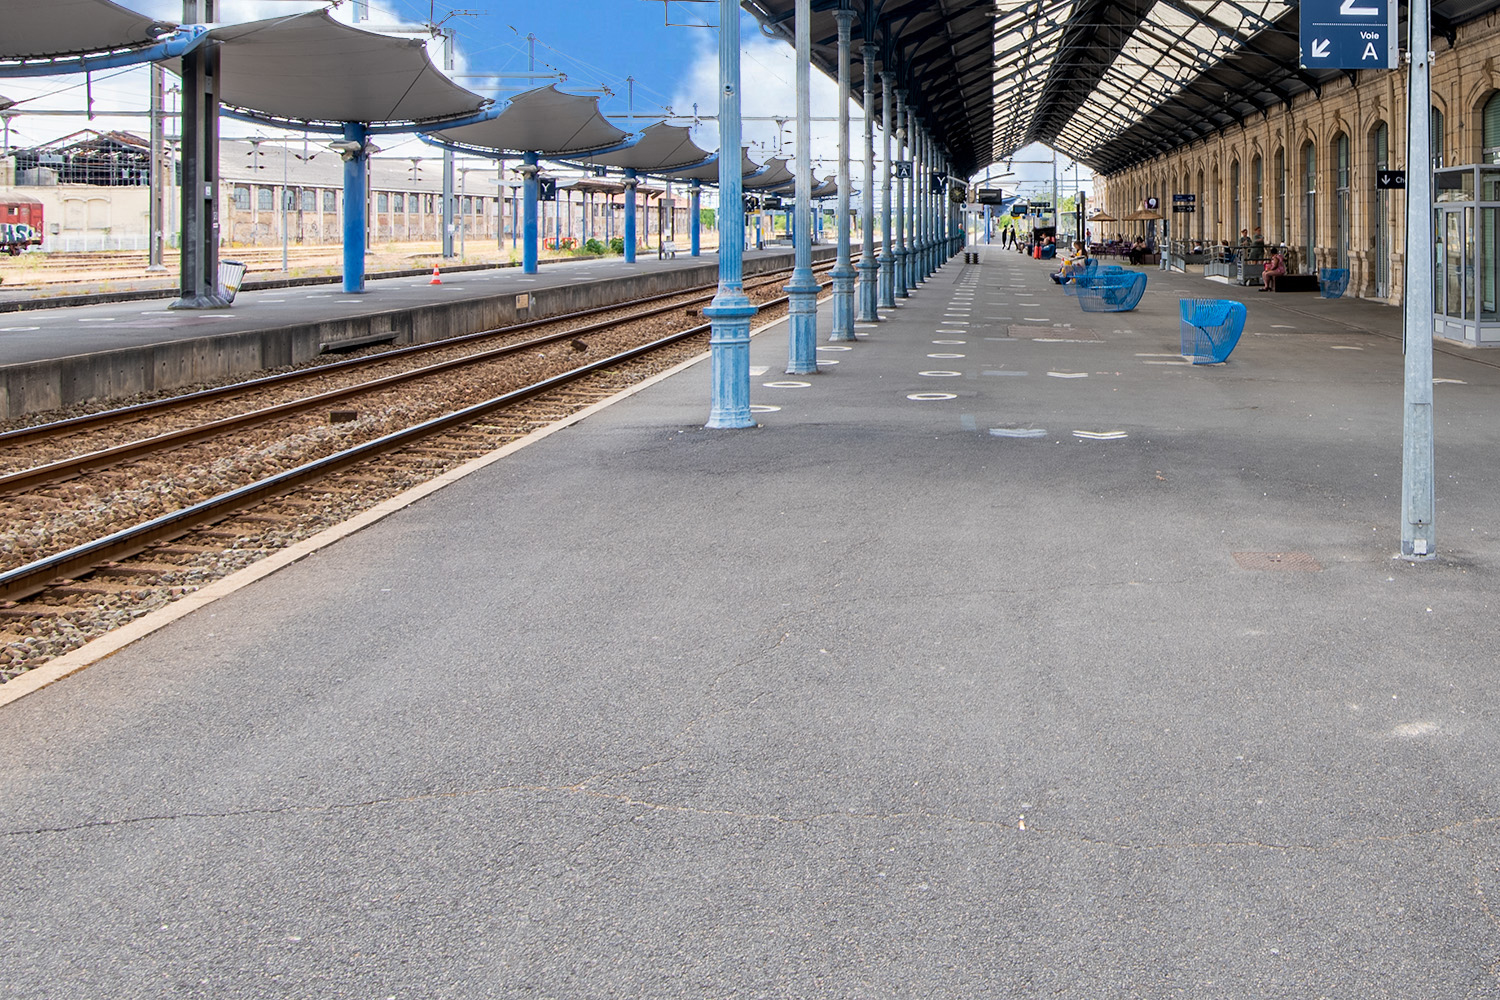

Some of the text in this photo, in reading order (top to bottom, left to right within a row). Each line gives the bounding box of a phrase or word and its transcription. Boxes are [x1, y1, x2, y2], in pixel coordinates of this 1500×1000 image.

[1360, 31, 1380, 40] Voie
[1362, 42, 1378, 60] A
[901, 168, 908, 176] A
[937, 176, 945, 186] Y
[1395, 176, 1405, 184] Ch
[541, 183, 550, 192] Y
